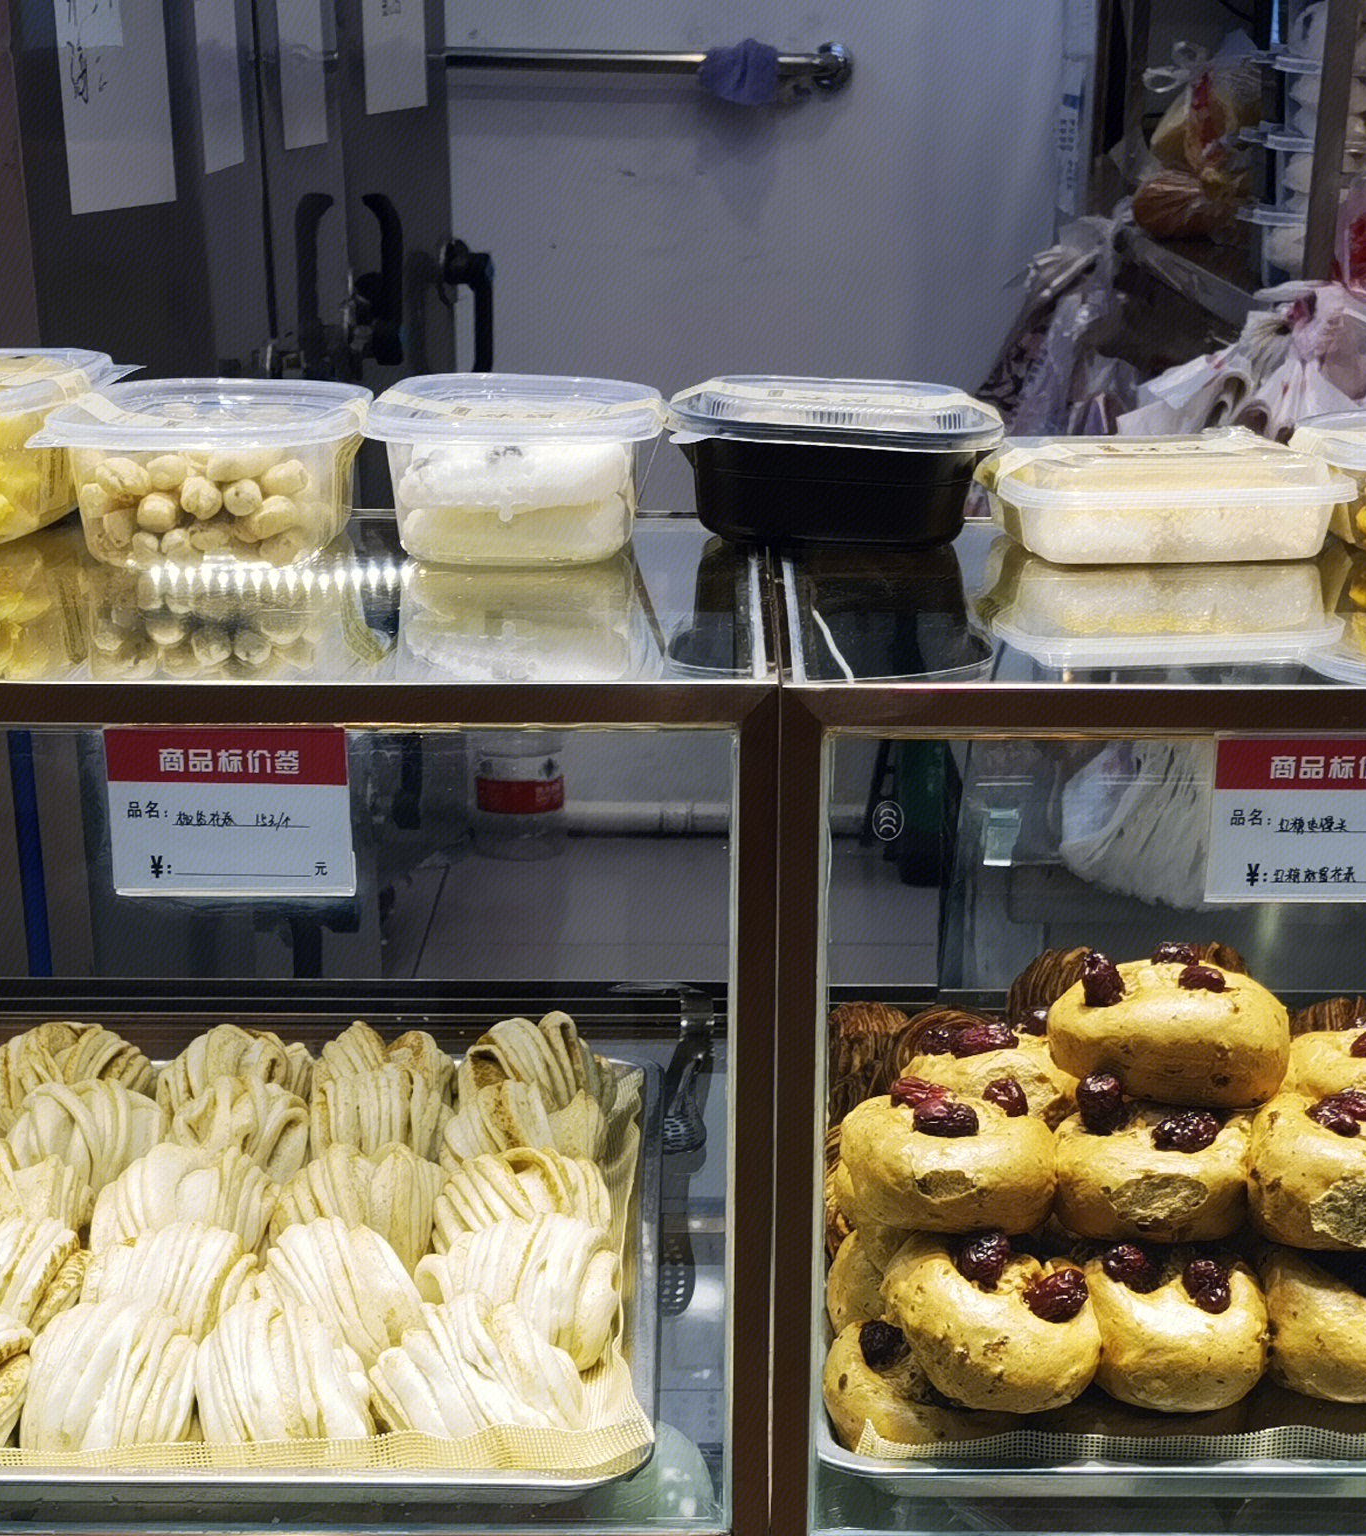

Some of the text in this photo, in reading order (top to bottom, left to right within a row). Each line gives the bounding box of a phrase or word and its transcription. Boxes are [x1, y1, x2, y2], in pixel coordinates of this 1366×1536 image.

[158, 748, 300, 775] 商品标价签
[314, 861, 328, 876] 元
